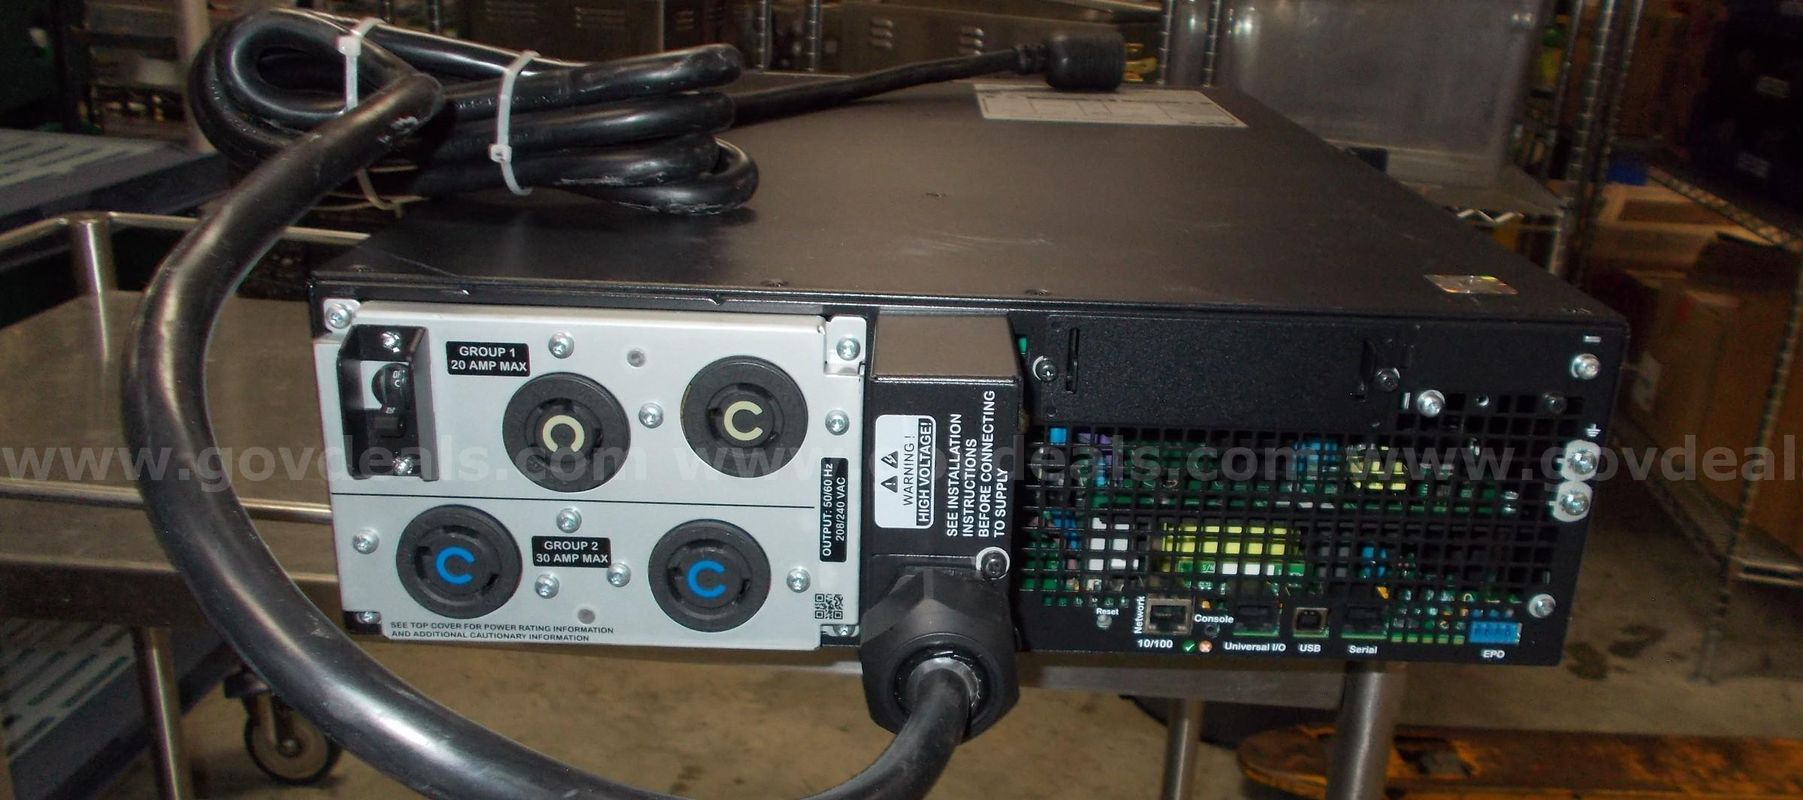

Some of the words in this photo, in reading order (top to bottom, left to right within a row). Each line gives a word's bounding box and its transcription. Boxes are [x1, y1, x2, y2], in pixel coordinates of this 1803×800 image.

[459, 346, 506, 357] GROUP
[510, 348, 516, 358] 1
[451, 360, 466, 370] 20
[469, 361, 497, 371] AMP
[500, 362, 527, 372] MAX
[981, 390, 996, 482] CONNECTING
[919, 422, 932, 488] VOLTAGE!
[948, 413, 962, 510] INSTALLATION
[824, 464, 833, 476] Hz
[824, 480, 832, 508] 50/60
[836, 477, 846, 499] VAC
[963, 438, 977, 538] INSTRUCTIONS
[995, 468, 1008, 516] SUPPLY
[918, 489, 930, 522] HIGH
[978, 486, 991, 538] BEFORE
[836, 502, 846, 542] 208/240
[946, 512, 958, 537] SEE
[994, 520, 1005, 538] TO
[822, 509, 832, 557] OUTPUT:
[544, 541, 588, 550] GROUP
[592, 542, 598, 550] 2
[536, 554, 550, 562] 30
[554, 554, 580, 562] AMP
[582, 554, 608, 563] MAX
[1096, 608, 1119, 616] Reset
[1133, 596, 1146, 634] Network
[1194, 614, 1234, 624] Console
[470, 632, 526, 640] CAUTIONARY
[529, 634, 589, 642] INFORMATION
[553, 626, 614, 634] INFORMATION
[1137, 639, 1174, 648] 10/100
[1224, 642, 1270, 652] Universal
[1271, 643, 1287, 652] I/O
[1300, 644, 1322, 653] USB
[1348, 645, 1378, 654] Serial
[1482, 649, 1506, 658] EPO
